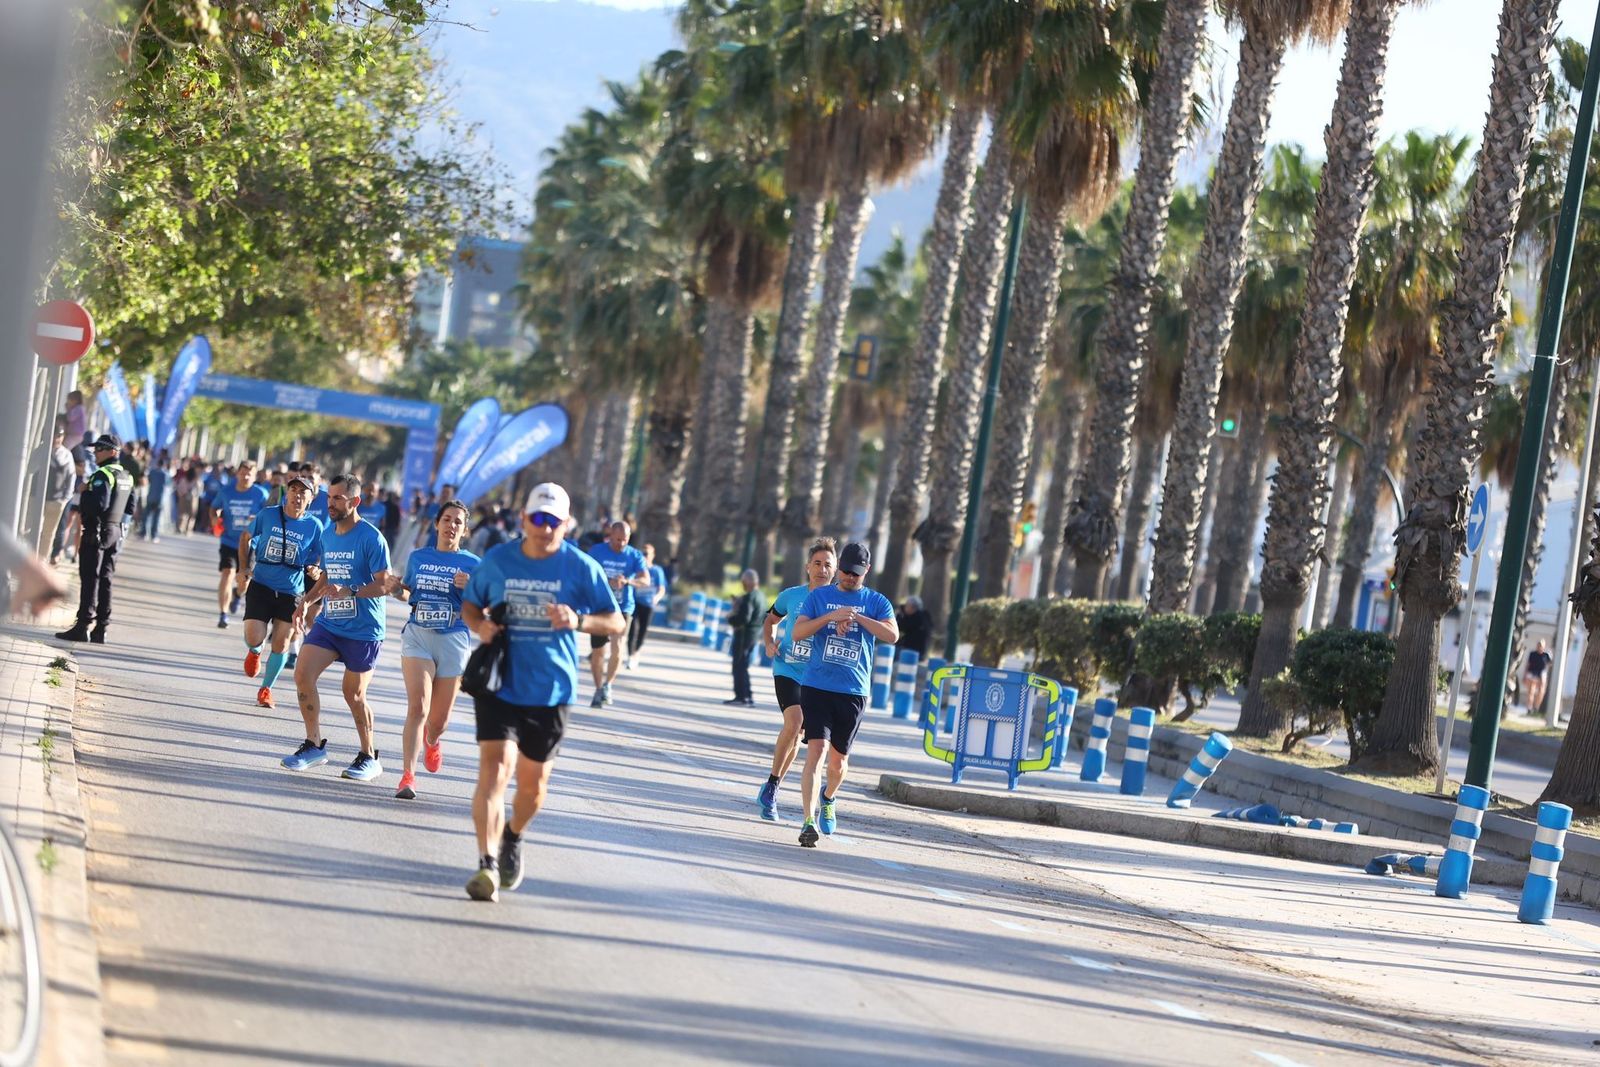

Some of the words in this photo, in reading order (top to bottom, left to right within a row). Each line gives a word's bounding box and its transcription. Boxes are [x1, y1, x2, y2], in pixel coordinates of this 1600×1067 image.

[368, 399, 432, 421] mayoral
[478, 419, 552, 480] mayoral
[270, 547, 293, 558] 183
[419, 563, 461, 574] mayoral
[505, 578, 562, 592] mayoral
[328, 600, 352, 610] 1543
[826, 602, 866, 614] maral
[419, 611, 448, 620] 1544
[827, 624, 859, 633] FRDS
[797, 646, 809, 656] 17
[830, 646, 857, 659] 1580
